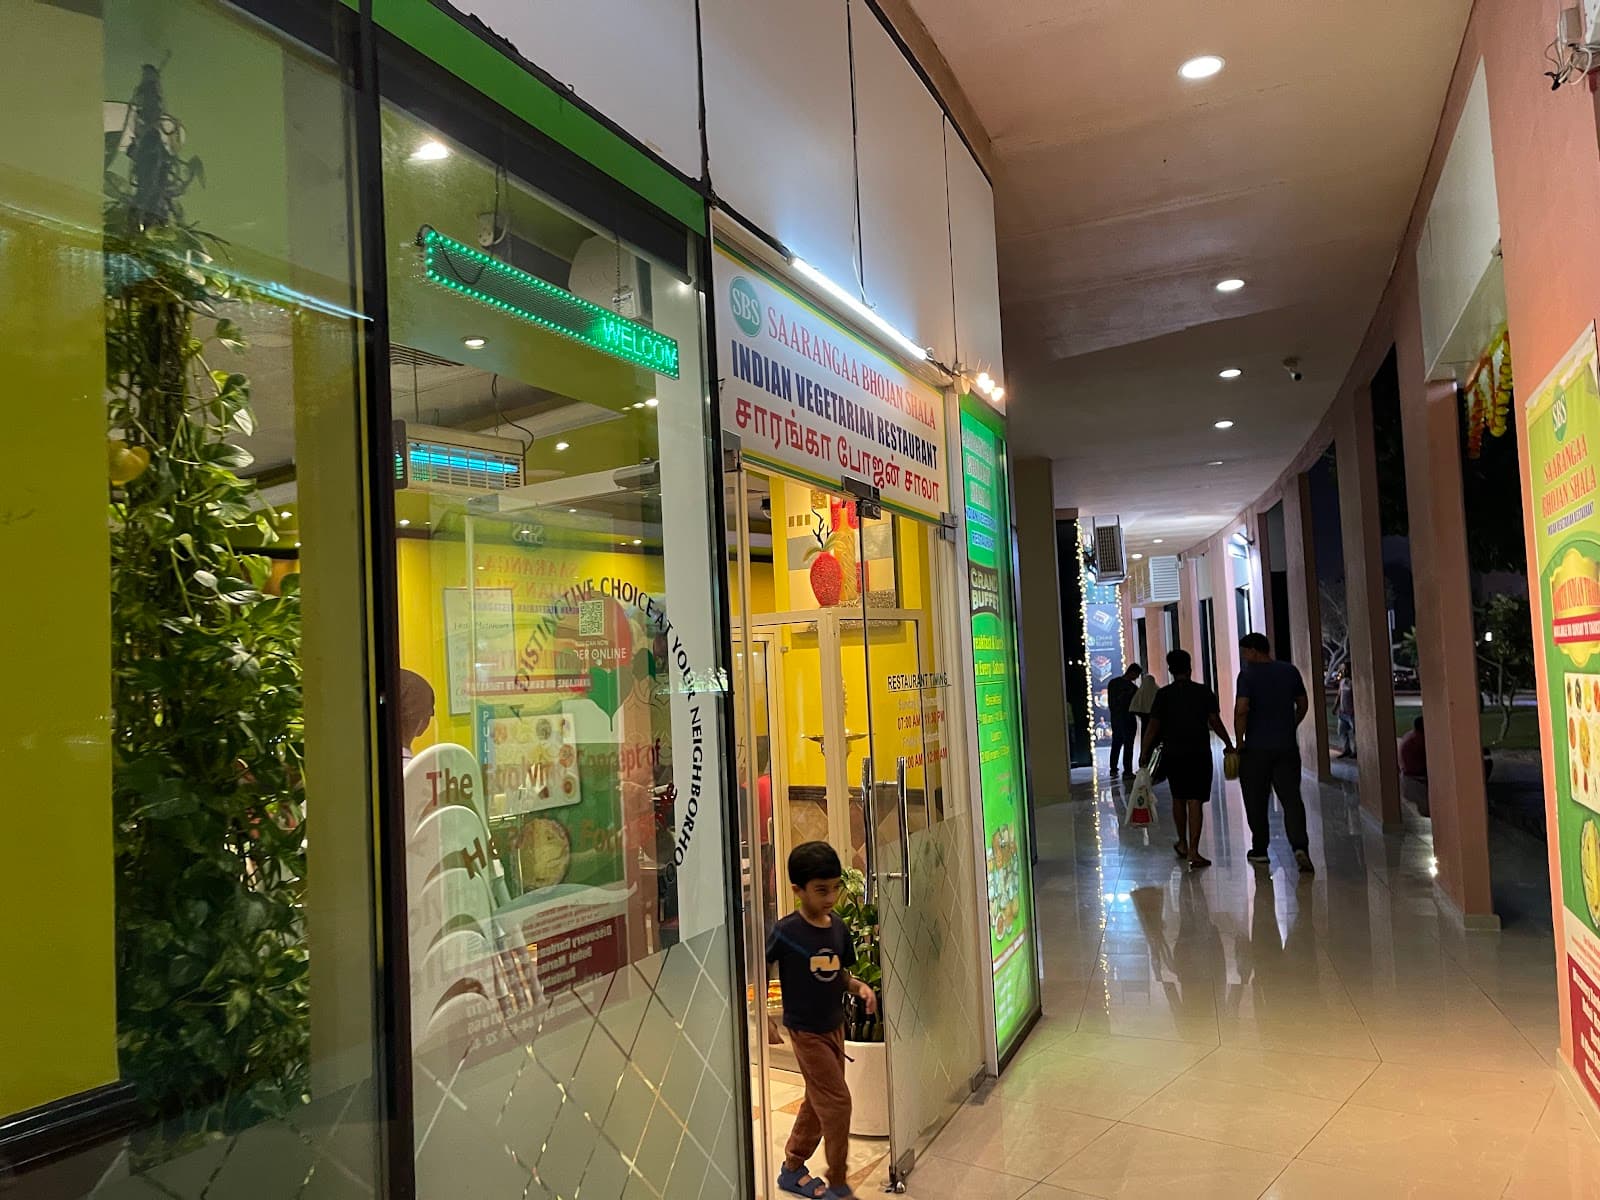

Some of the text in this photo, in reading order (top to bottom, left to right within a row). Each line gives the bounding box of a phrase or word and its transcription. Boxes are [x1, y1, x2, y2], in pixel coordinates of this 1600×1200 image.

[732, 288, 760, 326] SBS
[767, 306, 936, 430] SAARANGAA BHOJAN SHALA
[731, 340, 792, 402] INDIAN
[795, 373, 874, 440] VEGETARIAN
[877, 415, 937, 470] RESTAURANT
[735, 397, 831, 461] சாரங்கா
[837, 435, 900, 489] போஜன்
[904, 469, 939, 503] சாலா
[1570, 464, 1597, 502] SHALA
[972, 590, 999, 613] BUFFET
[515, 579, 594, 692] DISTINCTIVE
[600, 577, 655, 617] CHOICE
[655, 616, 674, 636] AT
[591, 647, 627, 660] ONLINE
[887, 673, 928, 690] RESTAURANT
[425, 768, 474, 806] The
